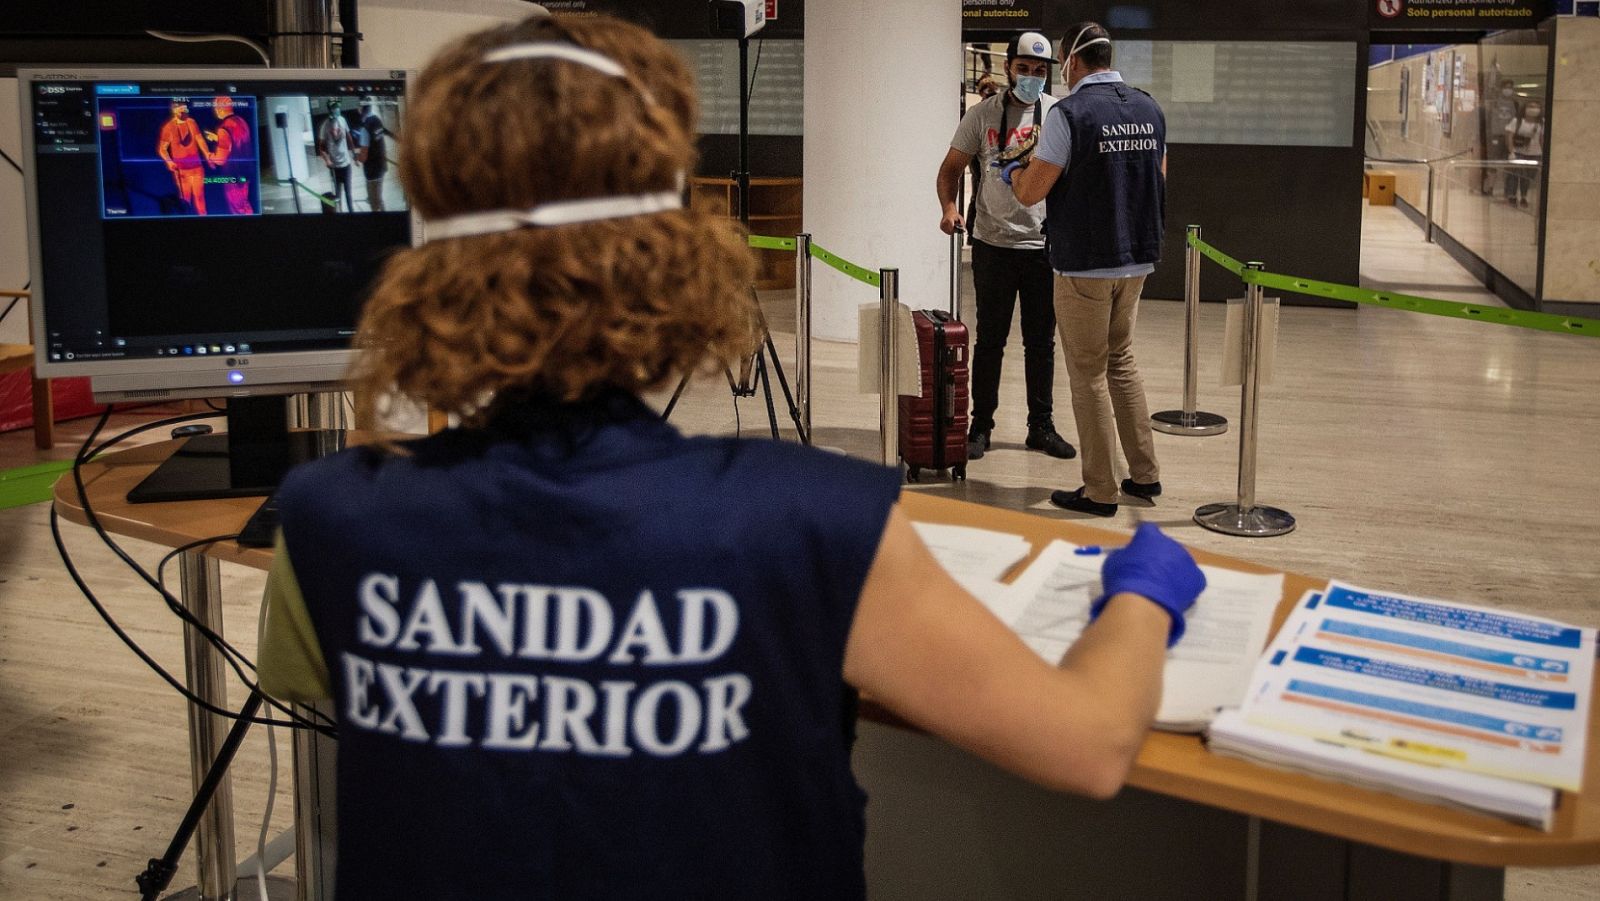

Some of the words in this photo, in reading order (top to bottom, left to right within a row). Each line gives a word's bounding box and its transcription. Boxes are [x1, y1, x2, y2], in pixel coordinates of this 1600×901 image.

[963, 9, 982, 17] onal
[983, 9, 1029, 17] autorizado
[1407, 8, 1430, 17] Solo
[1431, 8, 1476, 18] personal
[1478, 8, 1533, 17] autorizado
[47, 86, 66, 94] DSS
[986, 126, 1035, 146] NAS
[1102, 122, 1154, 137] SANIDAD
[1099, 138, 1158, 153] EXTERIOR
[238, 358, 249, 366] LG
[356, 571, 740, 666] SANIDAD
[340, 650, 754, 758] EXTERIOR
